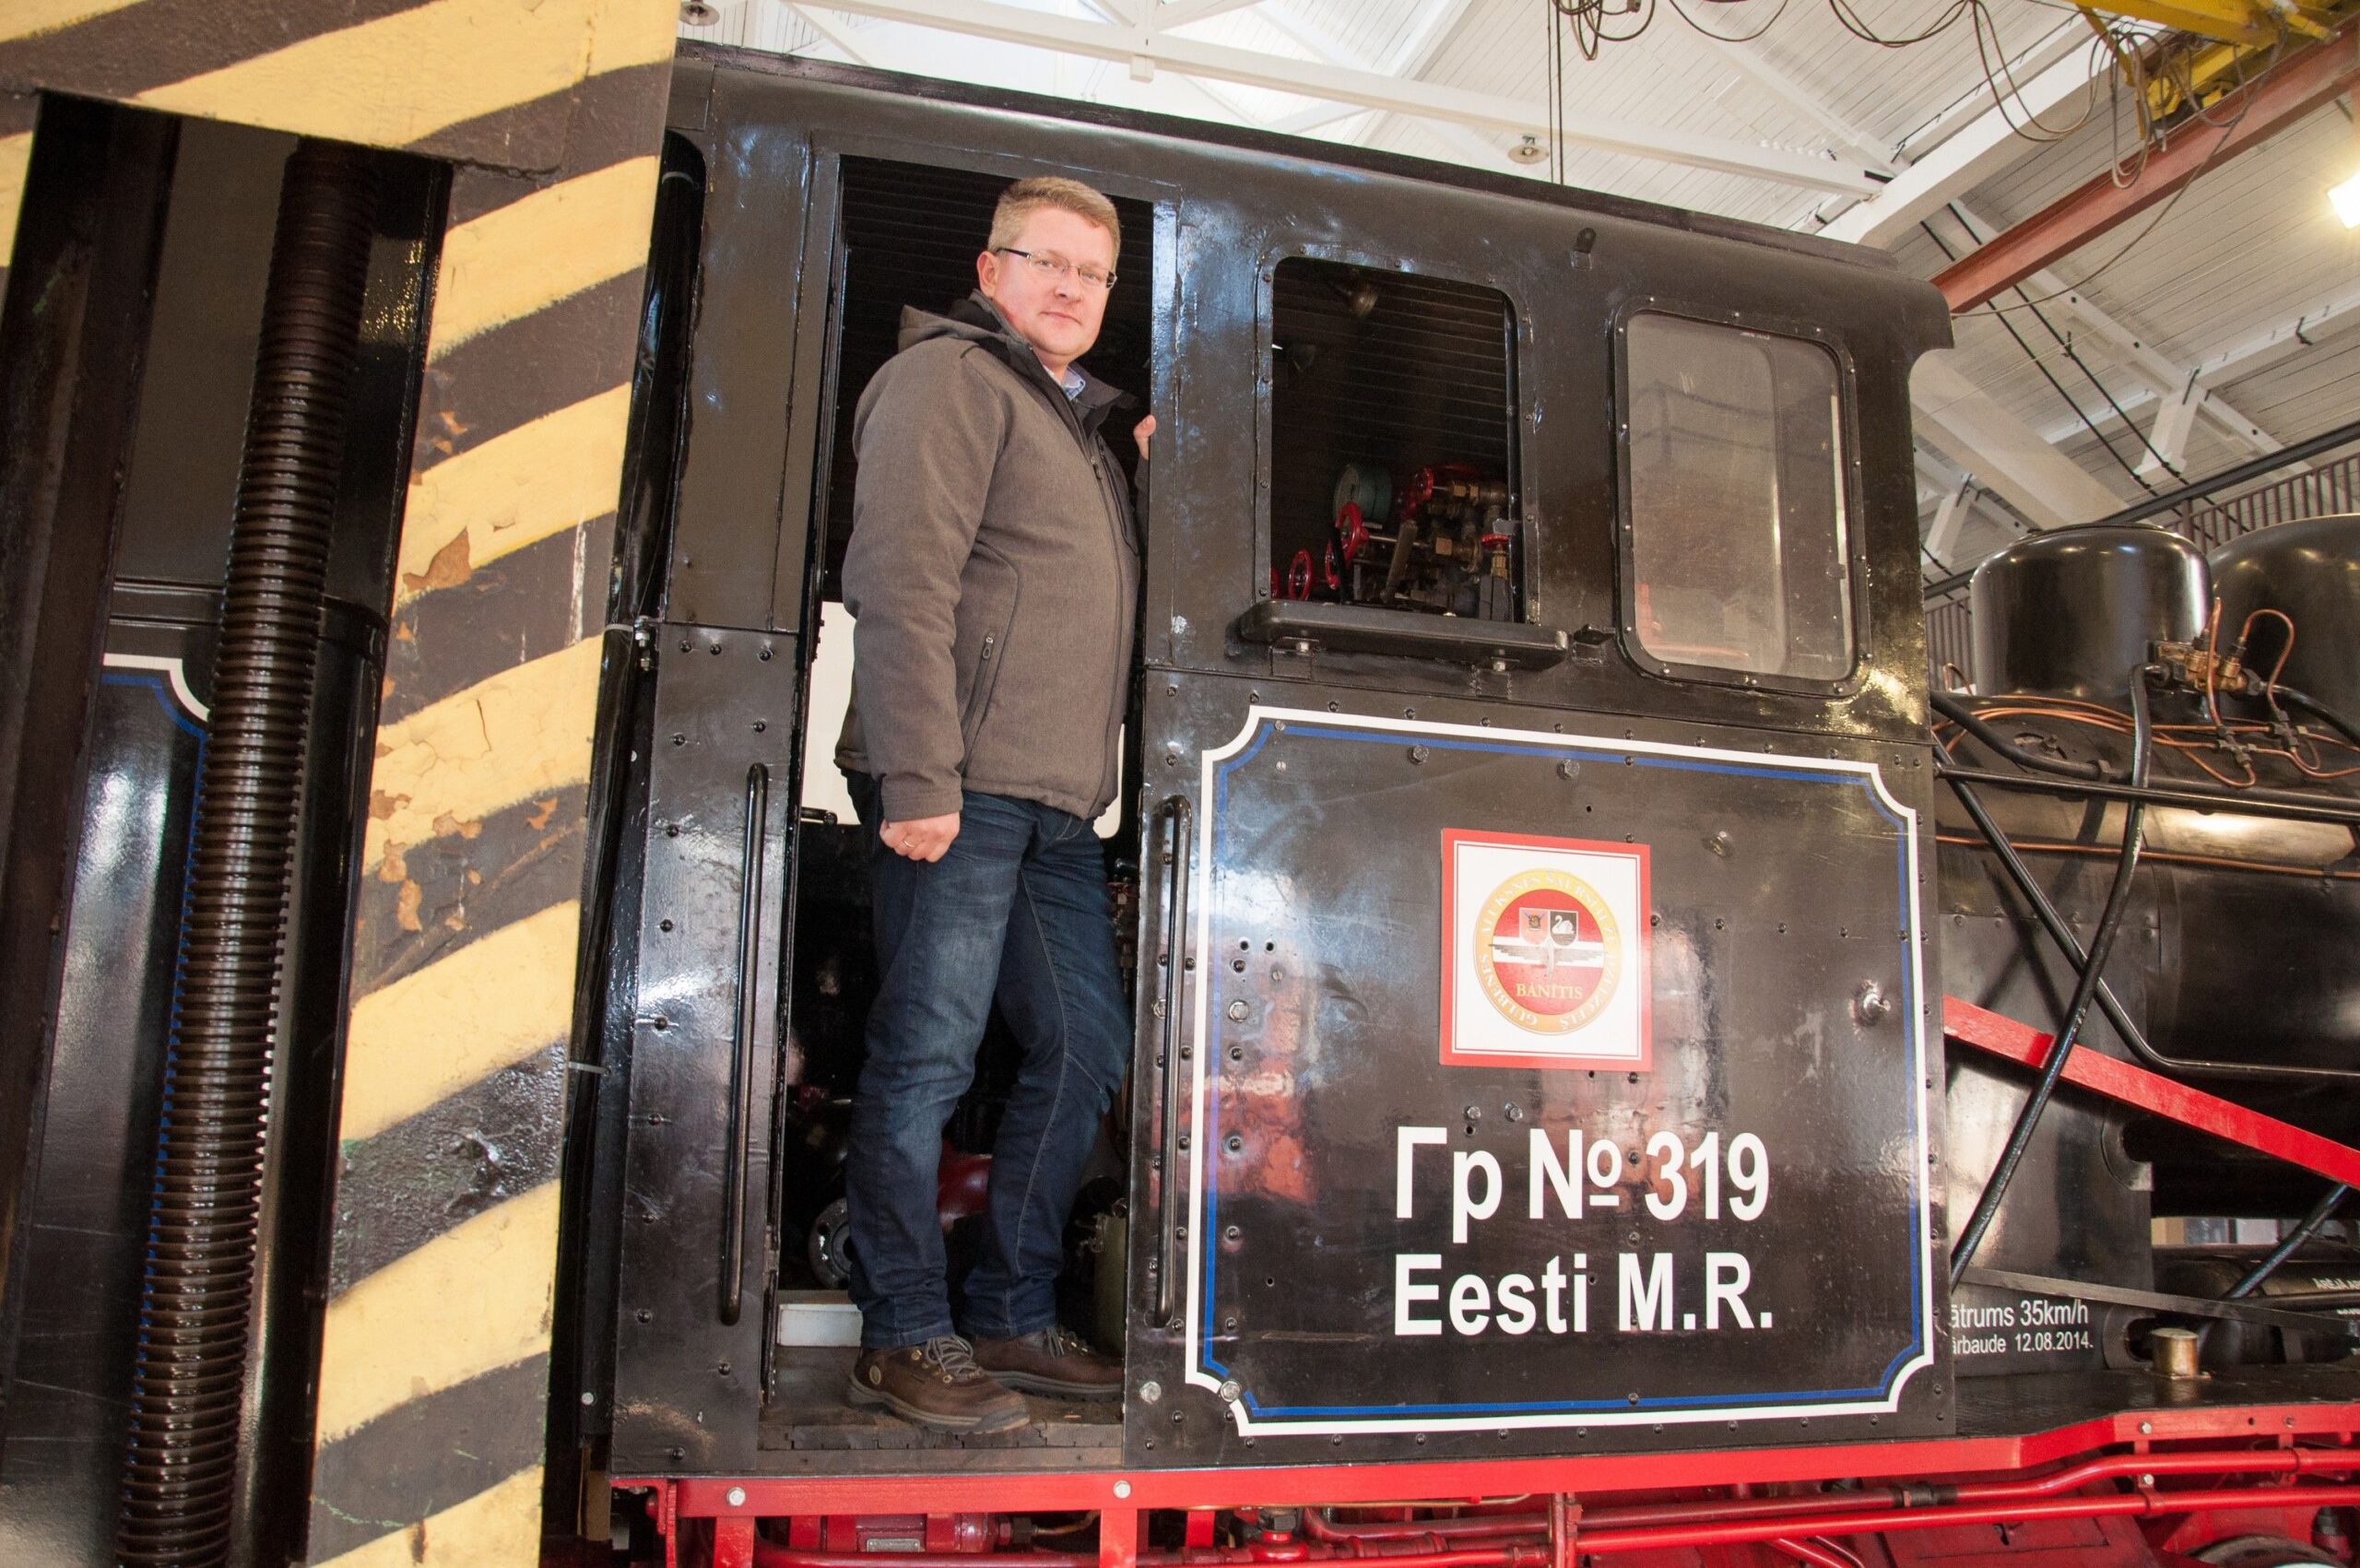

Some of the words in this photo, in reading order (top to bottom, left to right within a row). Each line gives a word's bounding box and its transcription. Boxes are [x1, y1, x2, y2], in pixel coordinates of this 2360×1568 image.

[1396, 1126, 1504, 1244] Гр
[1644, 1130, 1770, 1222] 319
[1394, 1254, 1587, 1337] Eesti
[1618, 1252, 1774, 1333] M.R.
[2019, 1299, 2089, 1326] 35km/h
